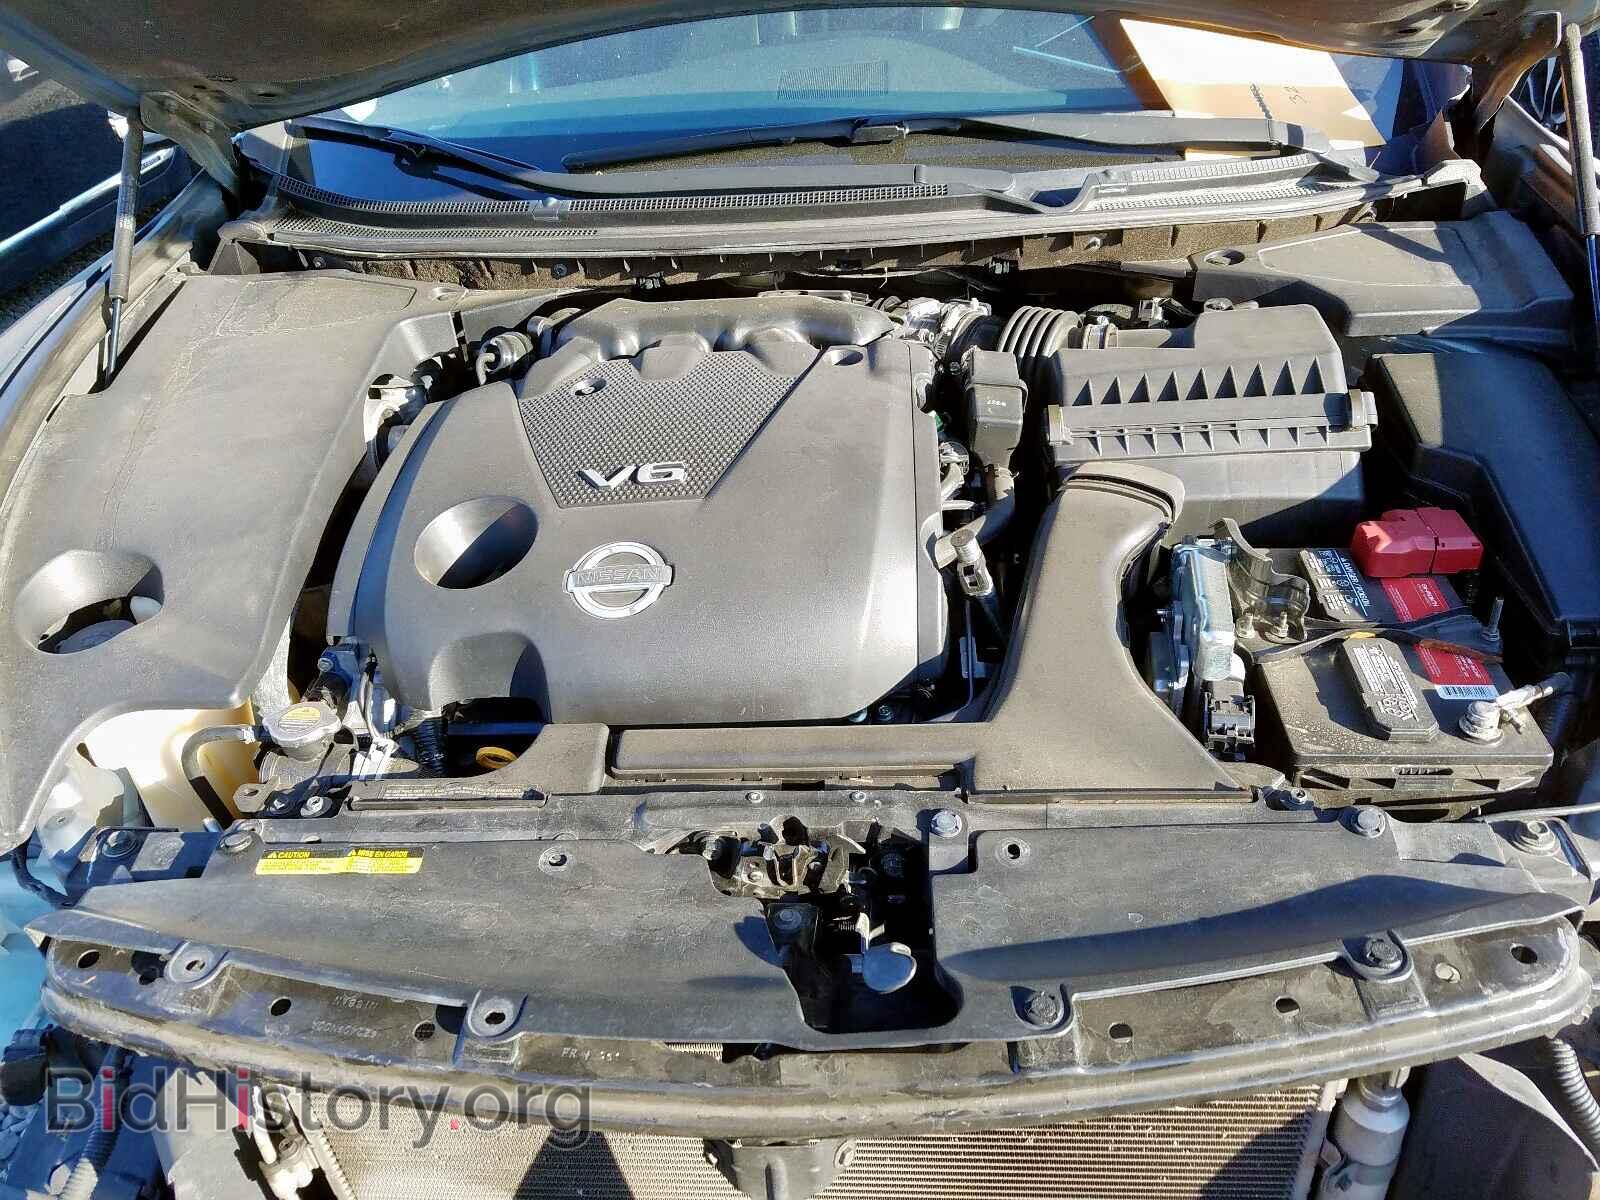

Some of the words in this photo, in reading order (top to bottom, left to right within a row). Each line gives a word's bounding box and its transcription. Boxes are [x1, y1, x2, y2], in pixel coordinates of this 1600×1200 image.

[577, 462, 687, 489] V6
[576, 565, 660, 585] NISSAN
[278, 851, 311, 859] CAUTION
